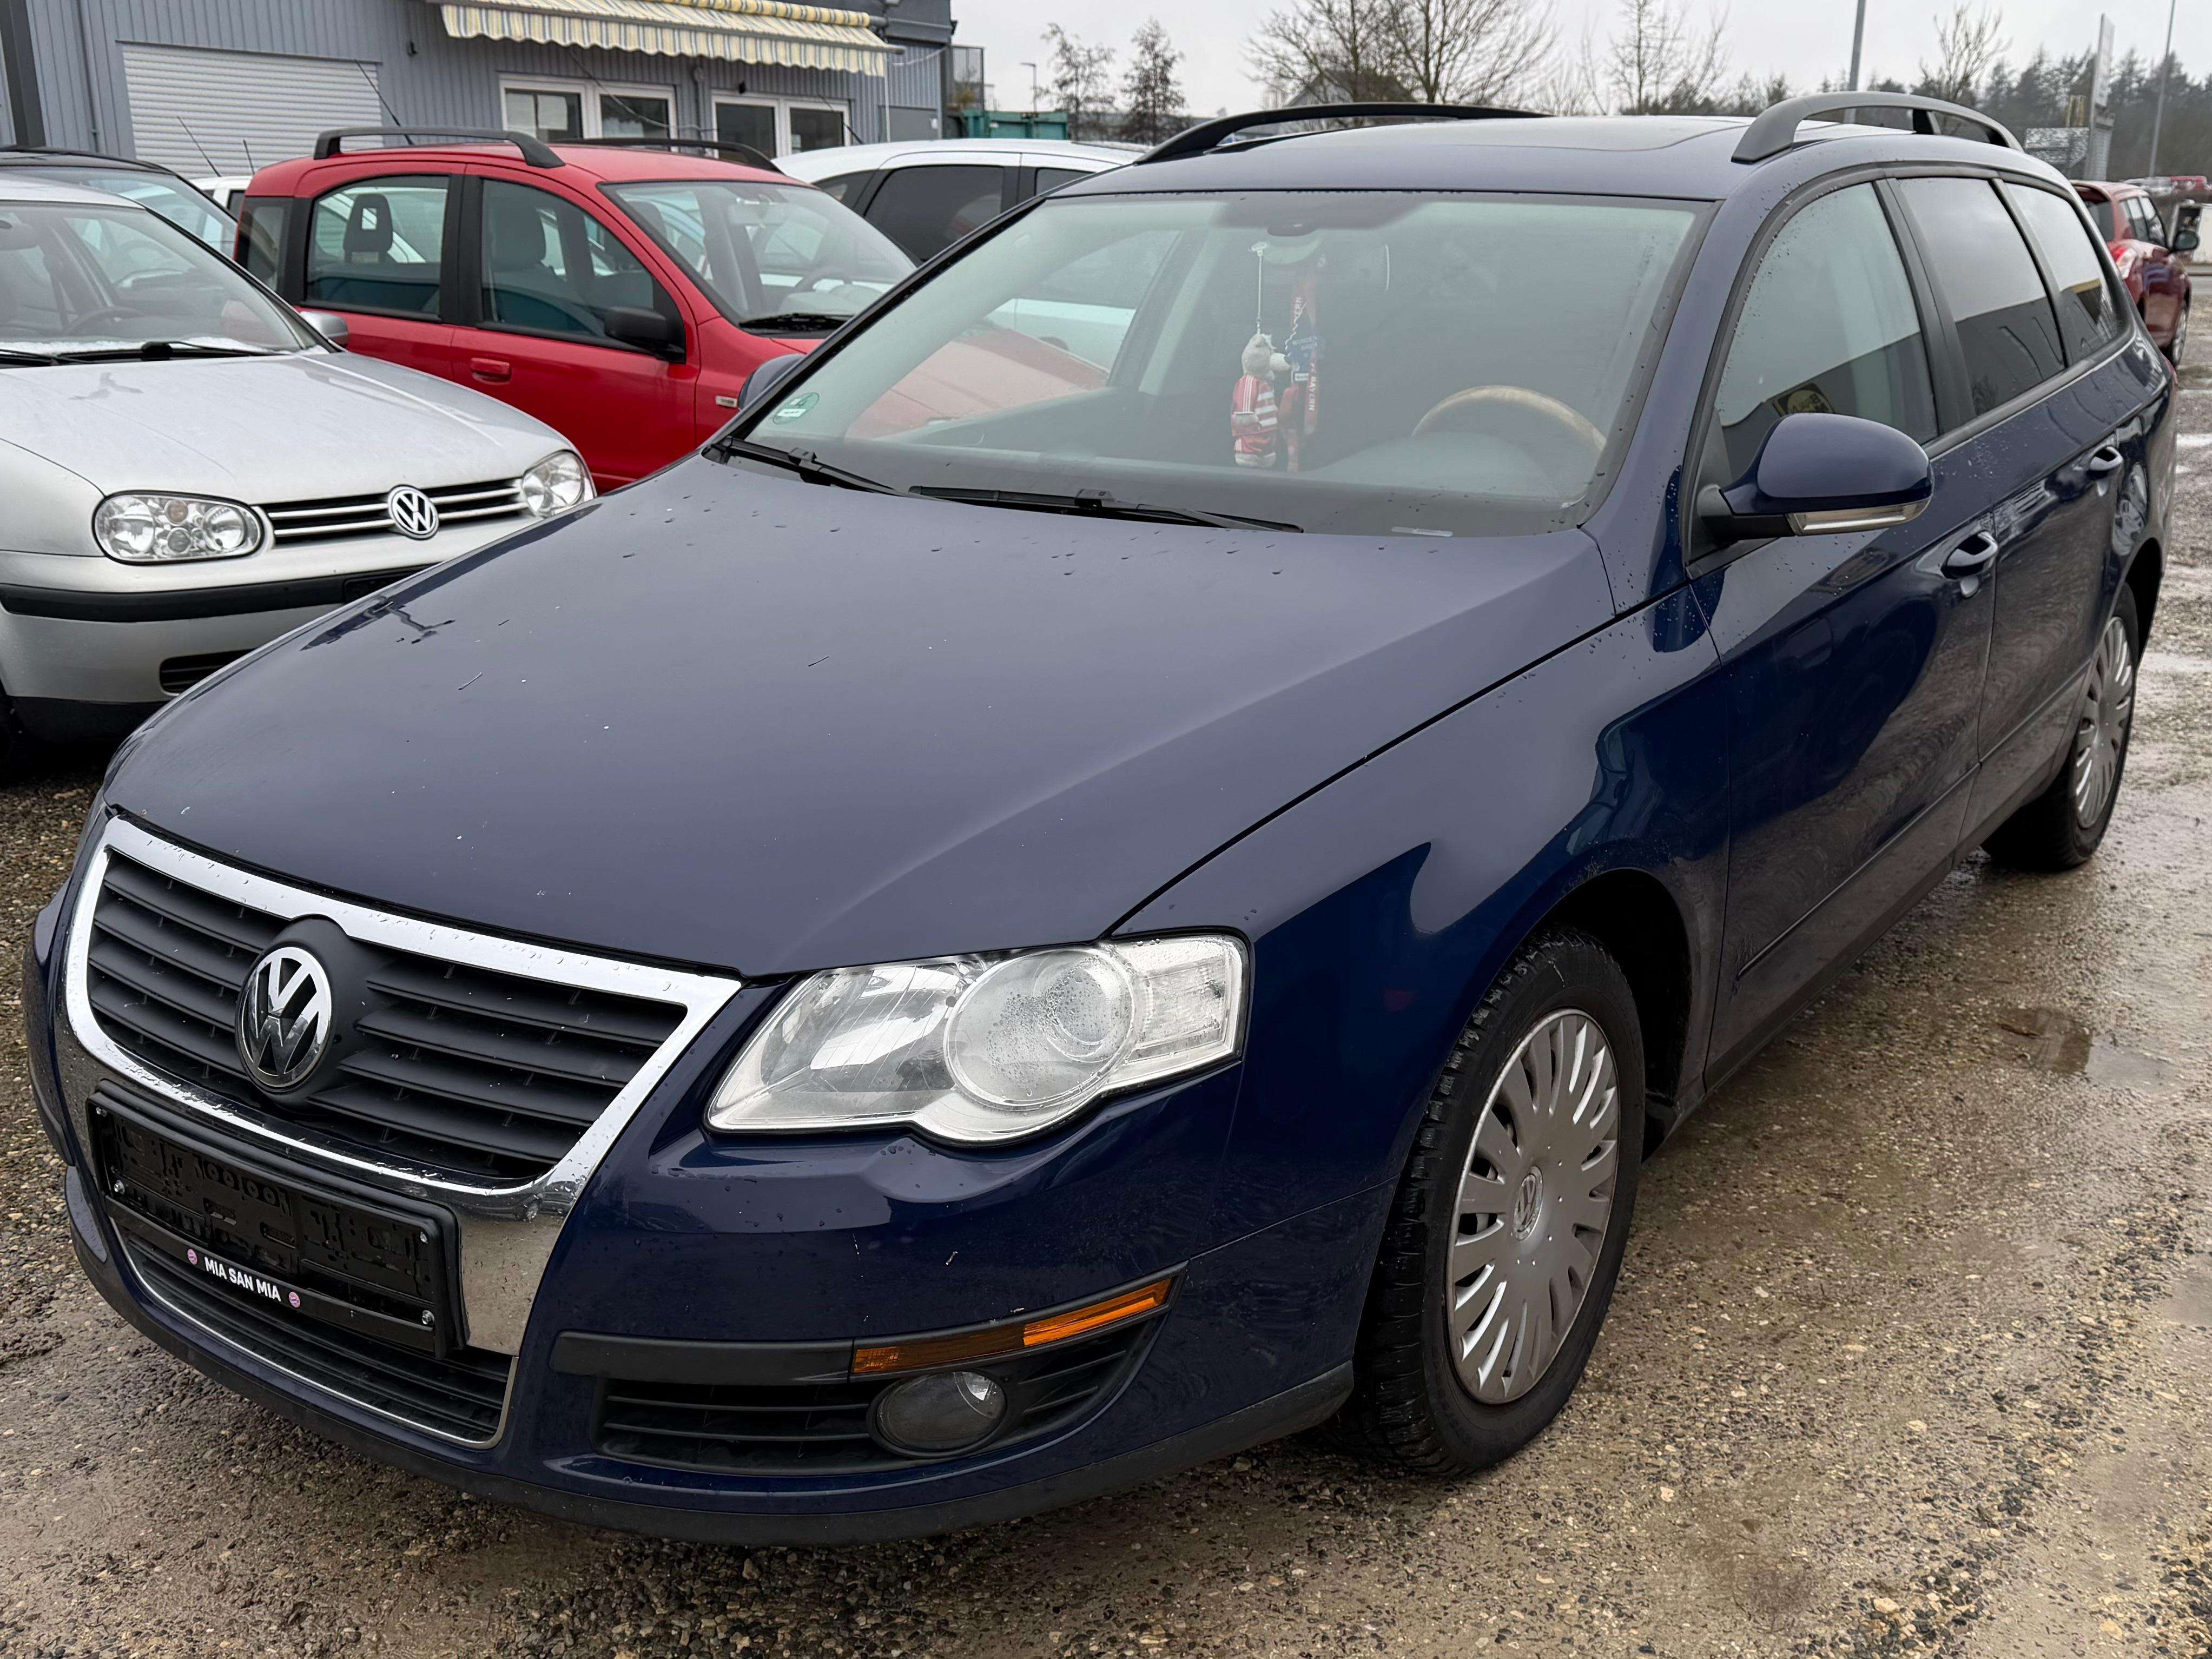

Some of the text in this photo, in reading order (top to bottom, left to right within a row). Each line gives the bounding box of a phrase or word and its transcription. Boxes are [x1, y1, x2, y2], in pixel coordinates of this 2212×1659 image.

[392, 488, 436, 535] VW
[243, 949, 331, 1085] VW
[204, 1257, 227, 1280] MIA
[228, 1268, 254, 1291] SAN
[256, 1279, 281, 1302] MIA
